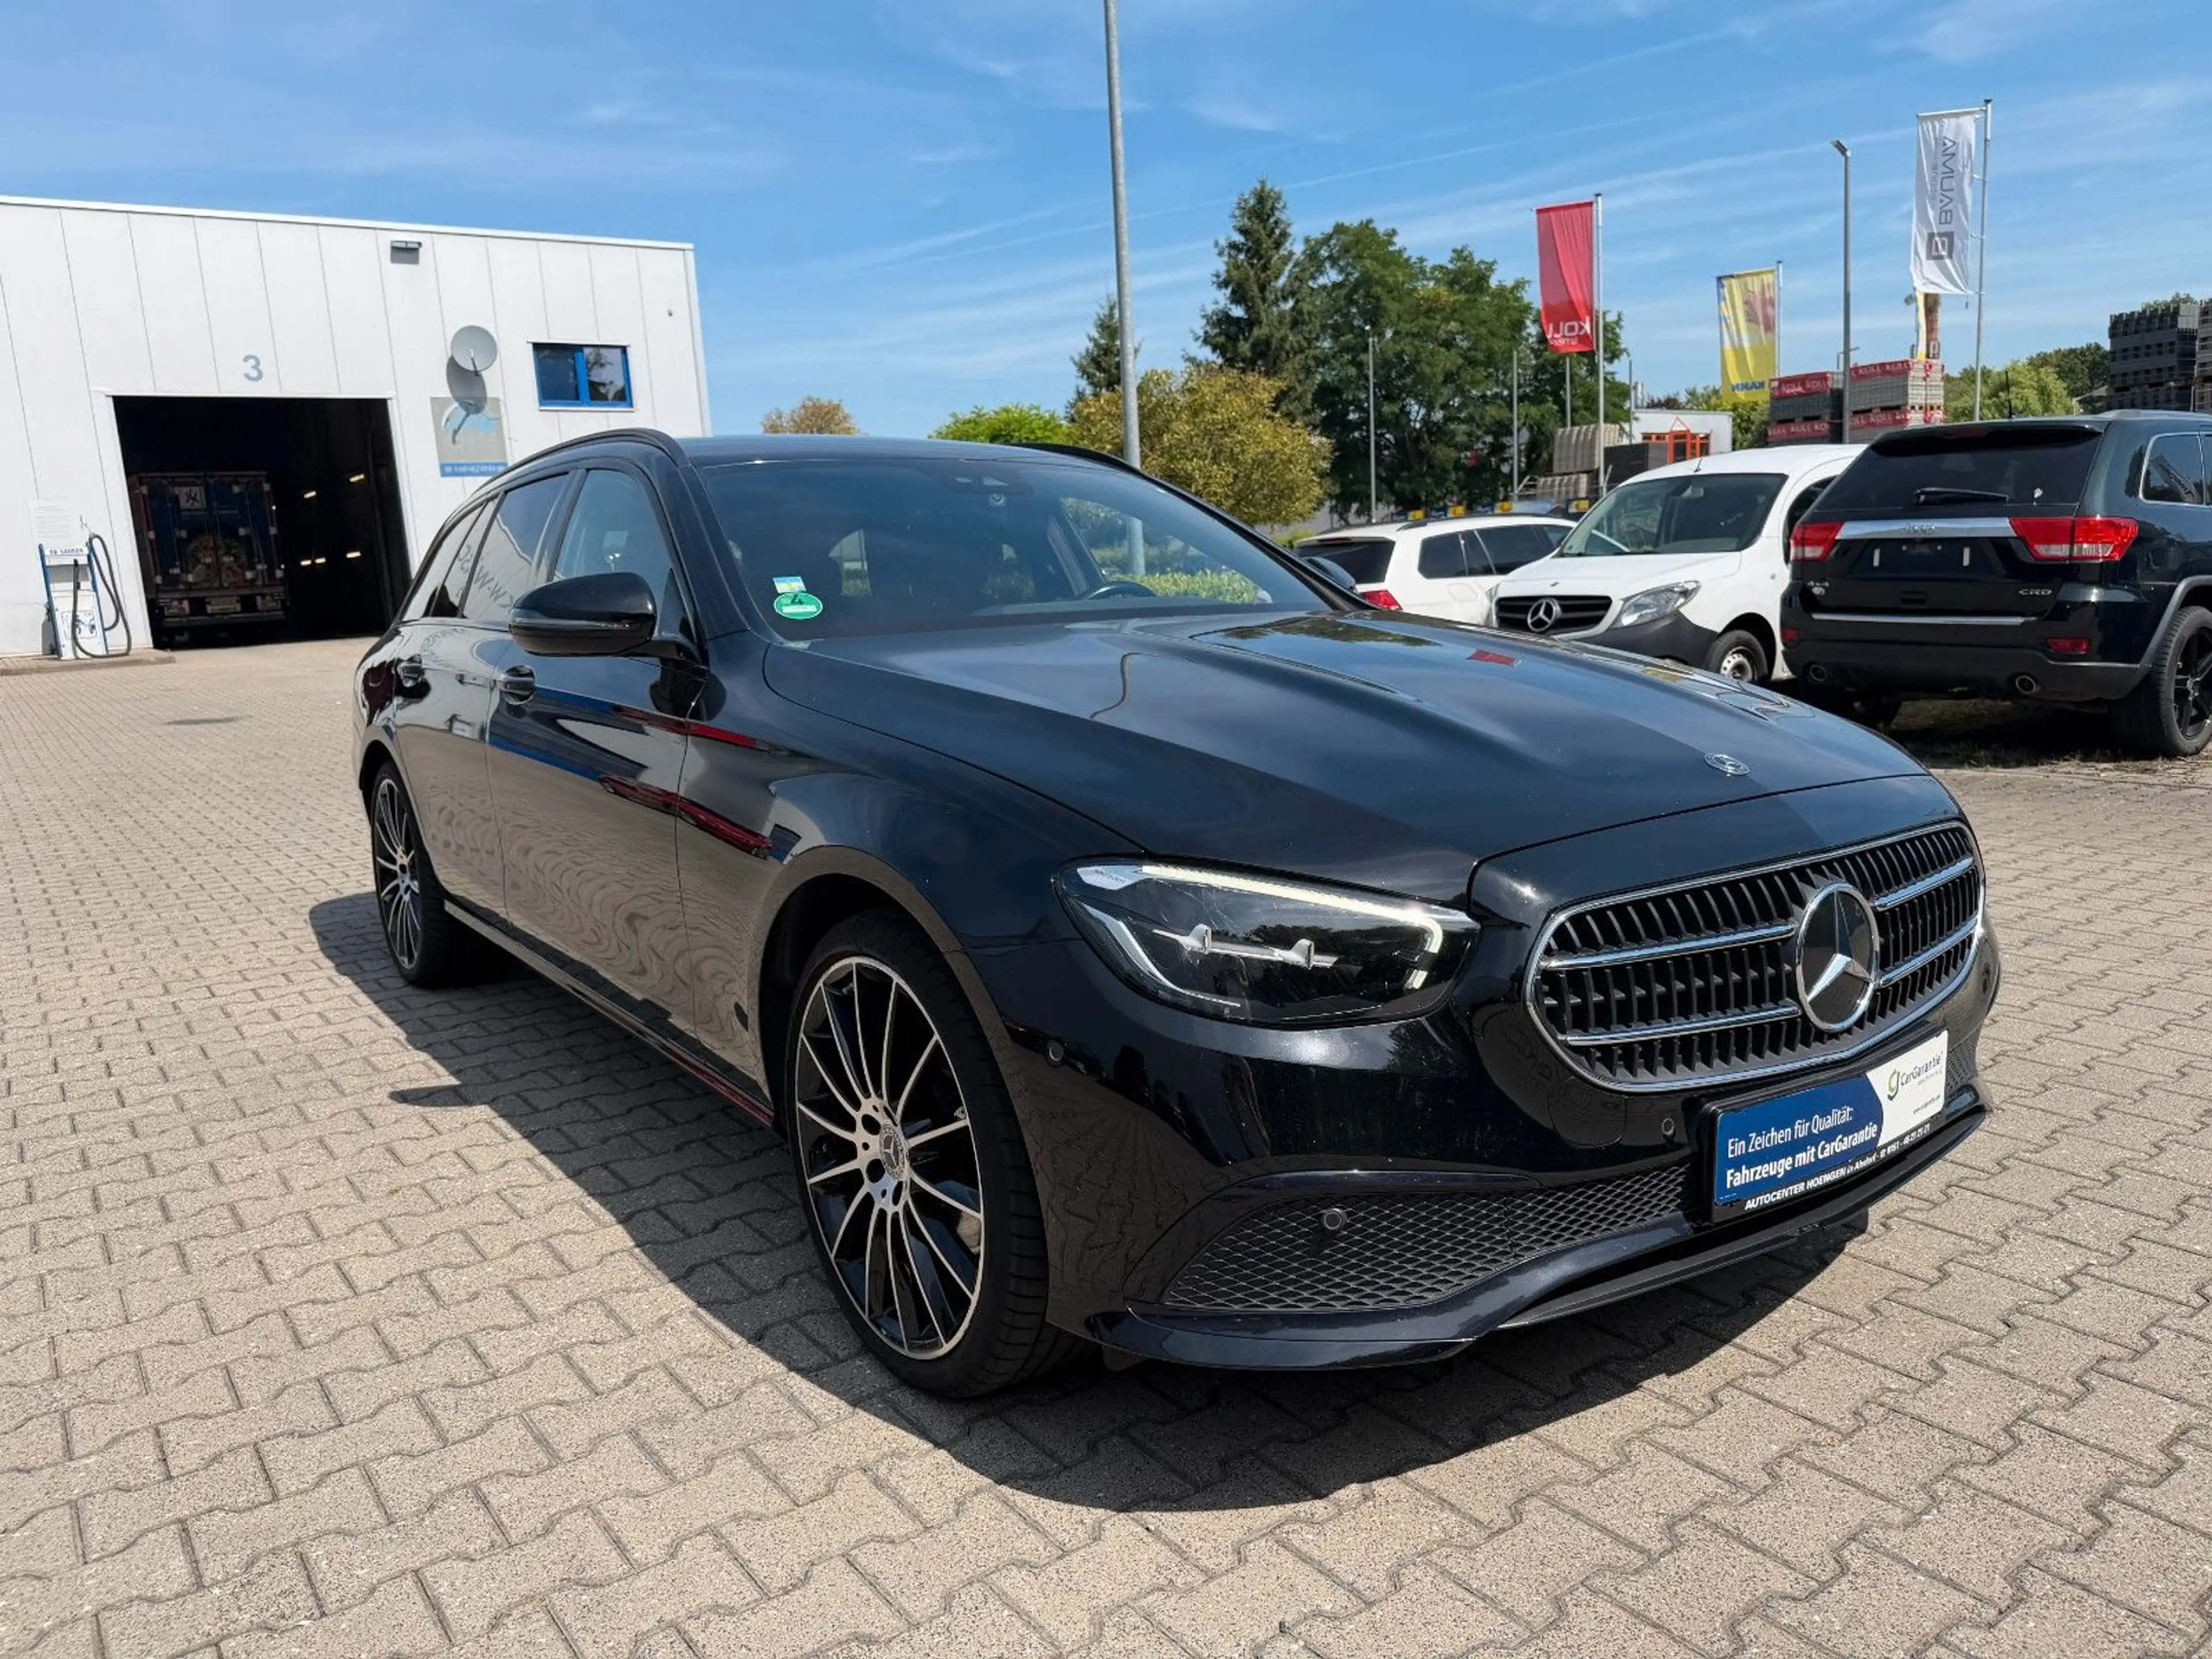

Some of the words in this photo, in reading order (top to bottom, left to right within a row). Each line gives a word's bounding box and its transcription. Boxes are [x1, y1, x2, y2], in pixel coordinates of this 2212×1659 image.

[243, 354, 264, 381] 3
[1726, 1157, 1793, 1189] Fahrzeuge
[1794, 1146, 1816, 1167] mit
[1817, 1122, 1877, 1159] CarGarantie
[1728, 1138, 1745, 1158] Ein
[1748, 1127, 1791, 1153] Zeichen
[1794, 1119, 1810, 1139] für
[1811, 1106, 1853, 1134] Qualität:
[1745, 1182, 1805, 1210] AUTOCENTER
[1806, 1167, 1847, 1190] HOENGEN
